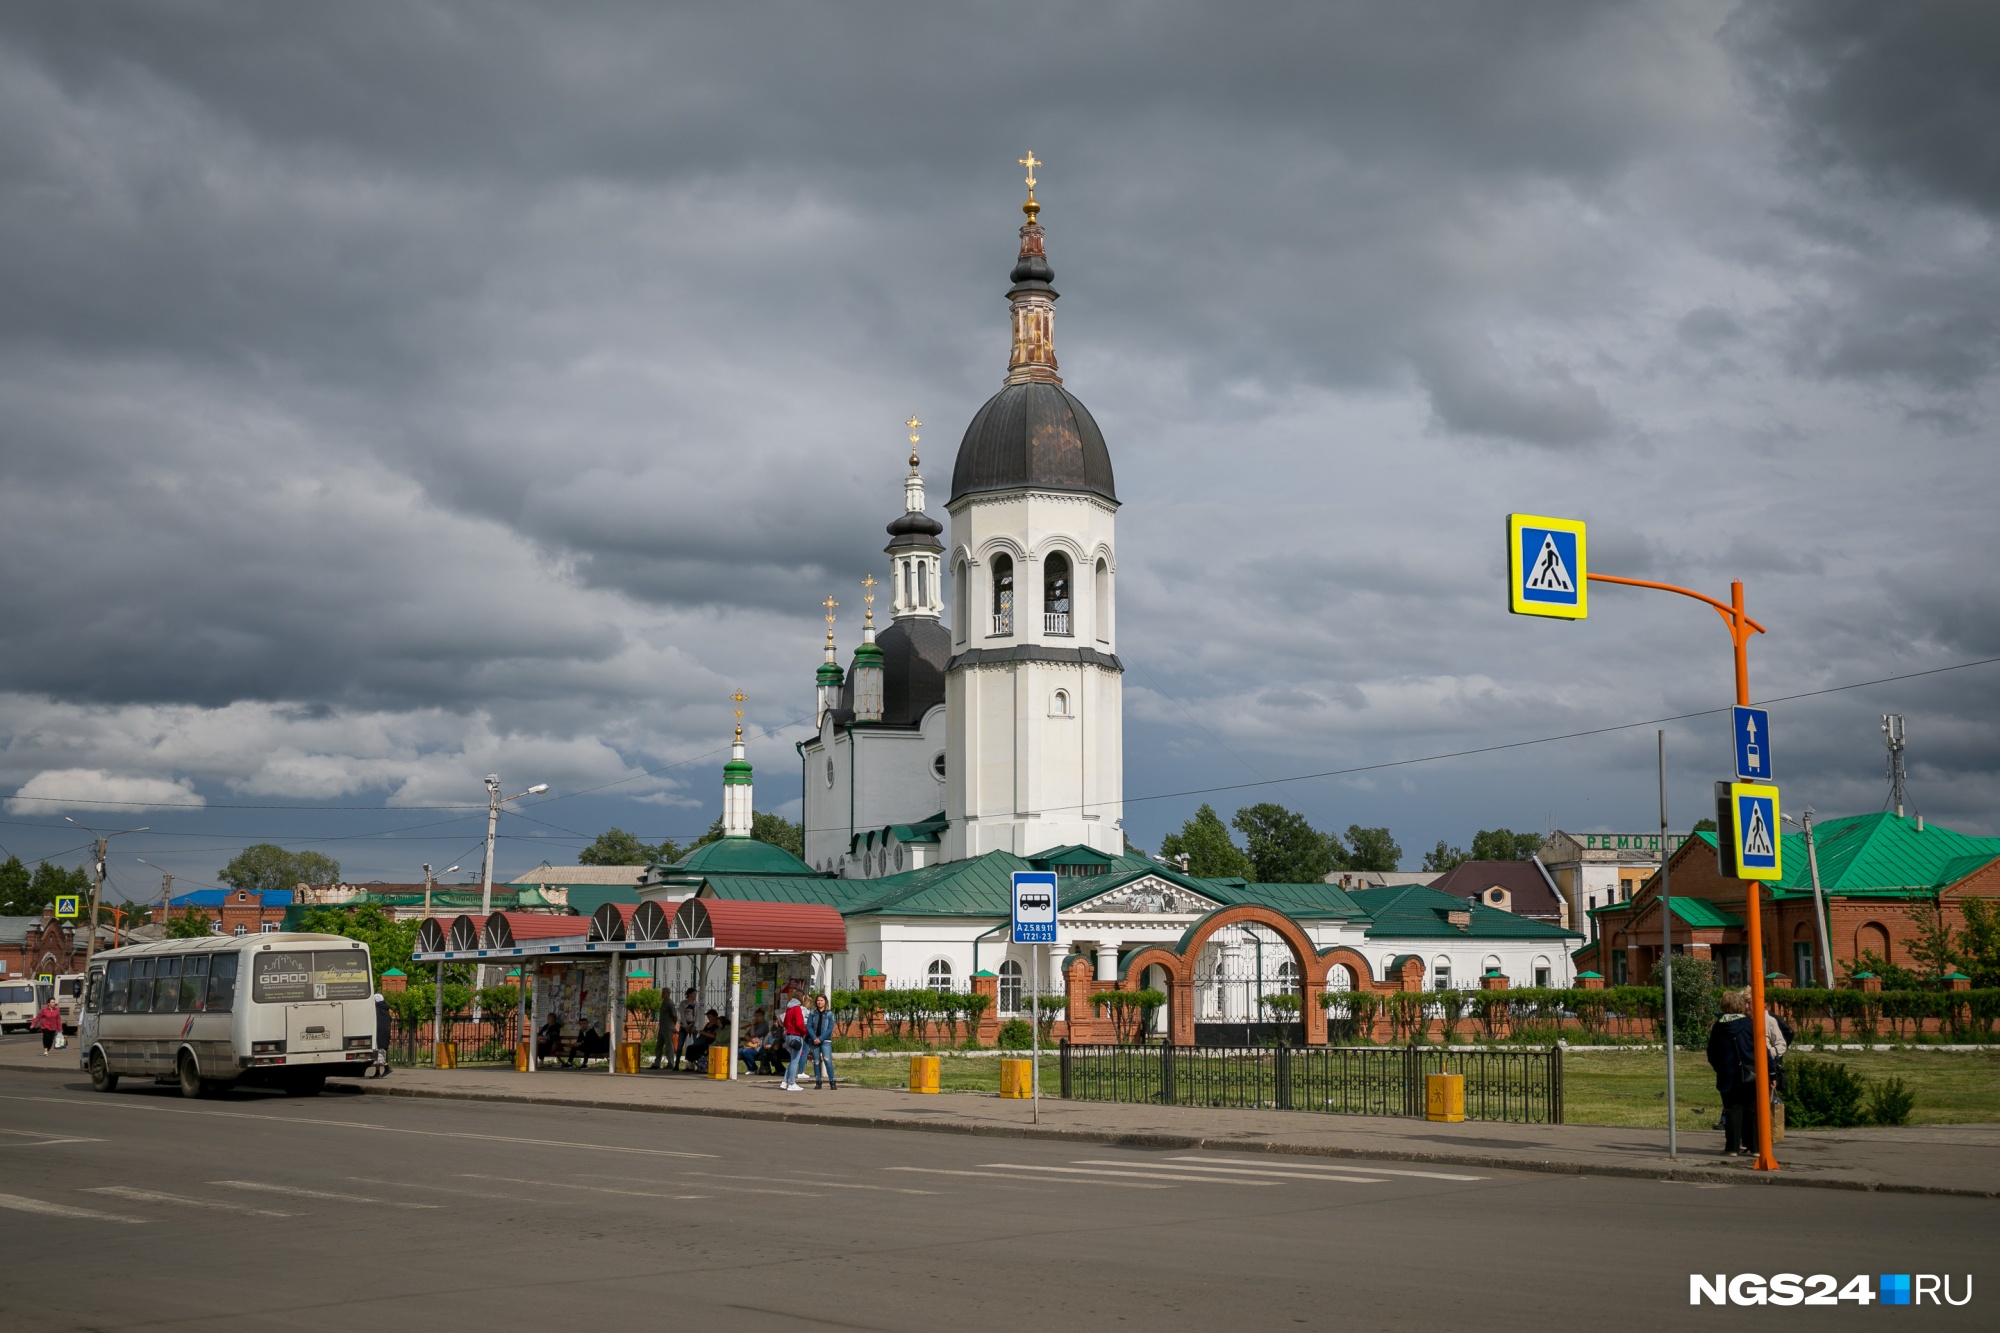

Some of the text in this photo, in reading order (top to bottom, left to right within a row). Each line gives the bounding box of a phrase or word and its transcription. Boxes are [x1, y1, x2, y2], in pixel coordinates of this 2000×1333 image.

[1017, 923, 1023, 931] А
[260, 973, 308, 984] GOROD
[316, 984, 325, 997] 21
